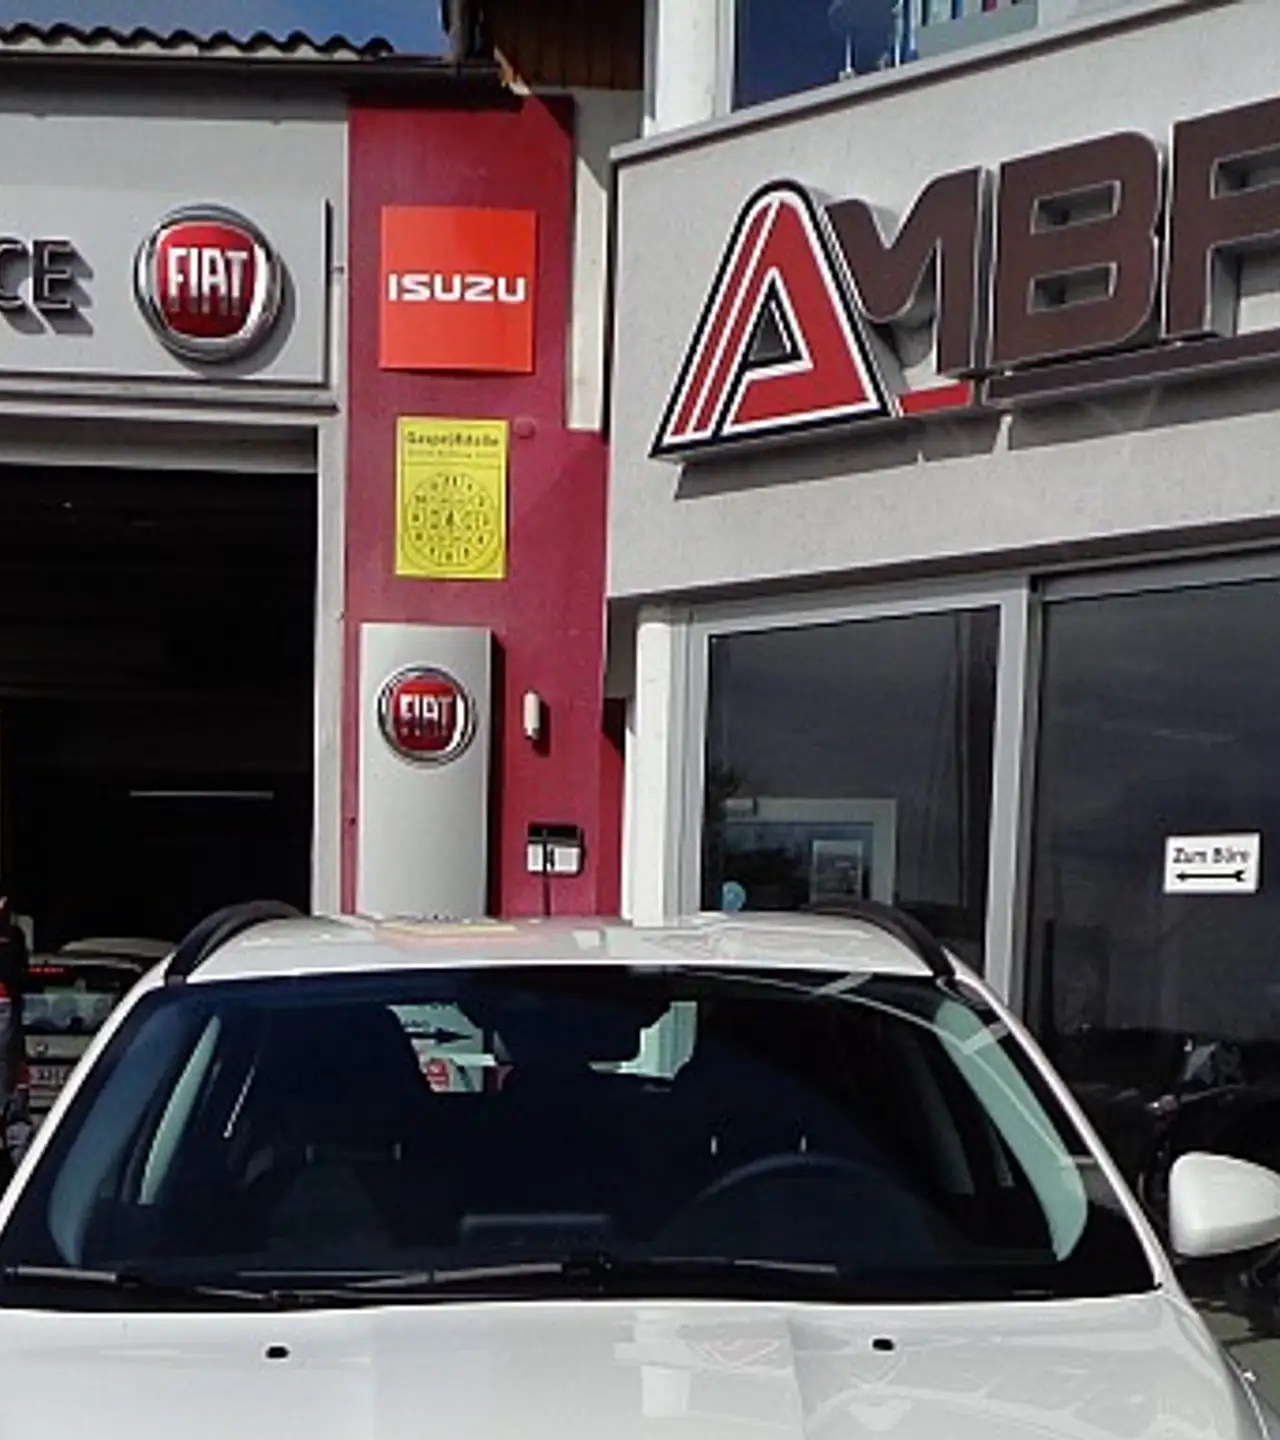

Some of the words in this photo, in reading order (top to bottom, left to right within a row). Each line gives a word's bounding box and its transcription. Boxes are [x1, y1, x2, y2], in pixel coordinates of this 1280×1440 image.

[167, 245, 249, 316] FIAT
[388, 273, 526, 303] ISUZU
[398, 692, 455, 736] FIAT
[1172, 847, 1207, 864] Zum
[1213, 846, 1250, 864] Büro
